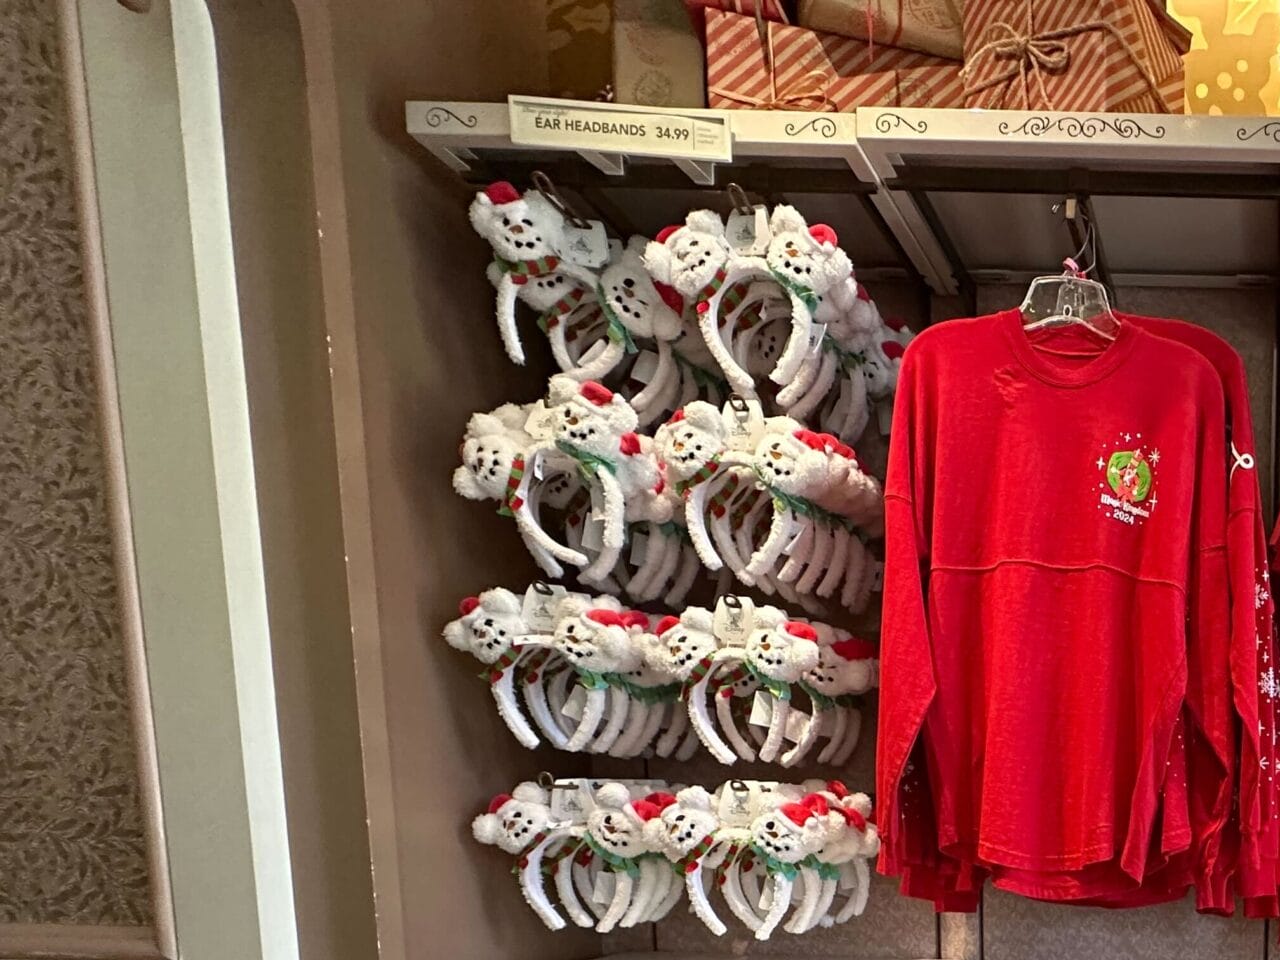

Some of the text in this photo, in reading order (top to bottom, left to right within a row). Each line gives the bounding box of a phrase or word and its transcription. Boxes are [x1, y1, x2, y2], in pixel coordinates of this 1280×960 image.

[535, 117, 561, 130] EAR
[565, 119, 647, 137] HEADBANDS
[656, 127, 690, 141] 34.99
[1113, 508, 1134, 525] 2024
